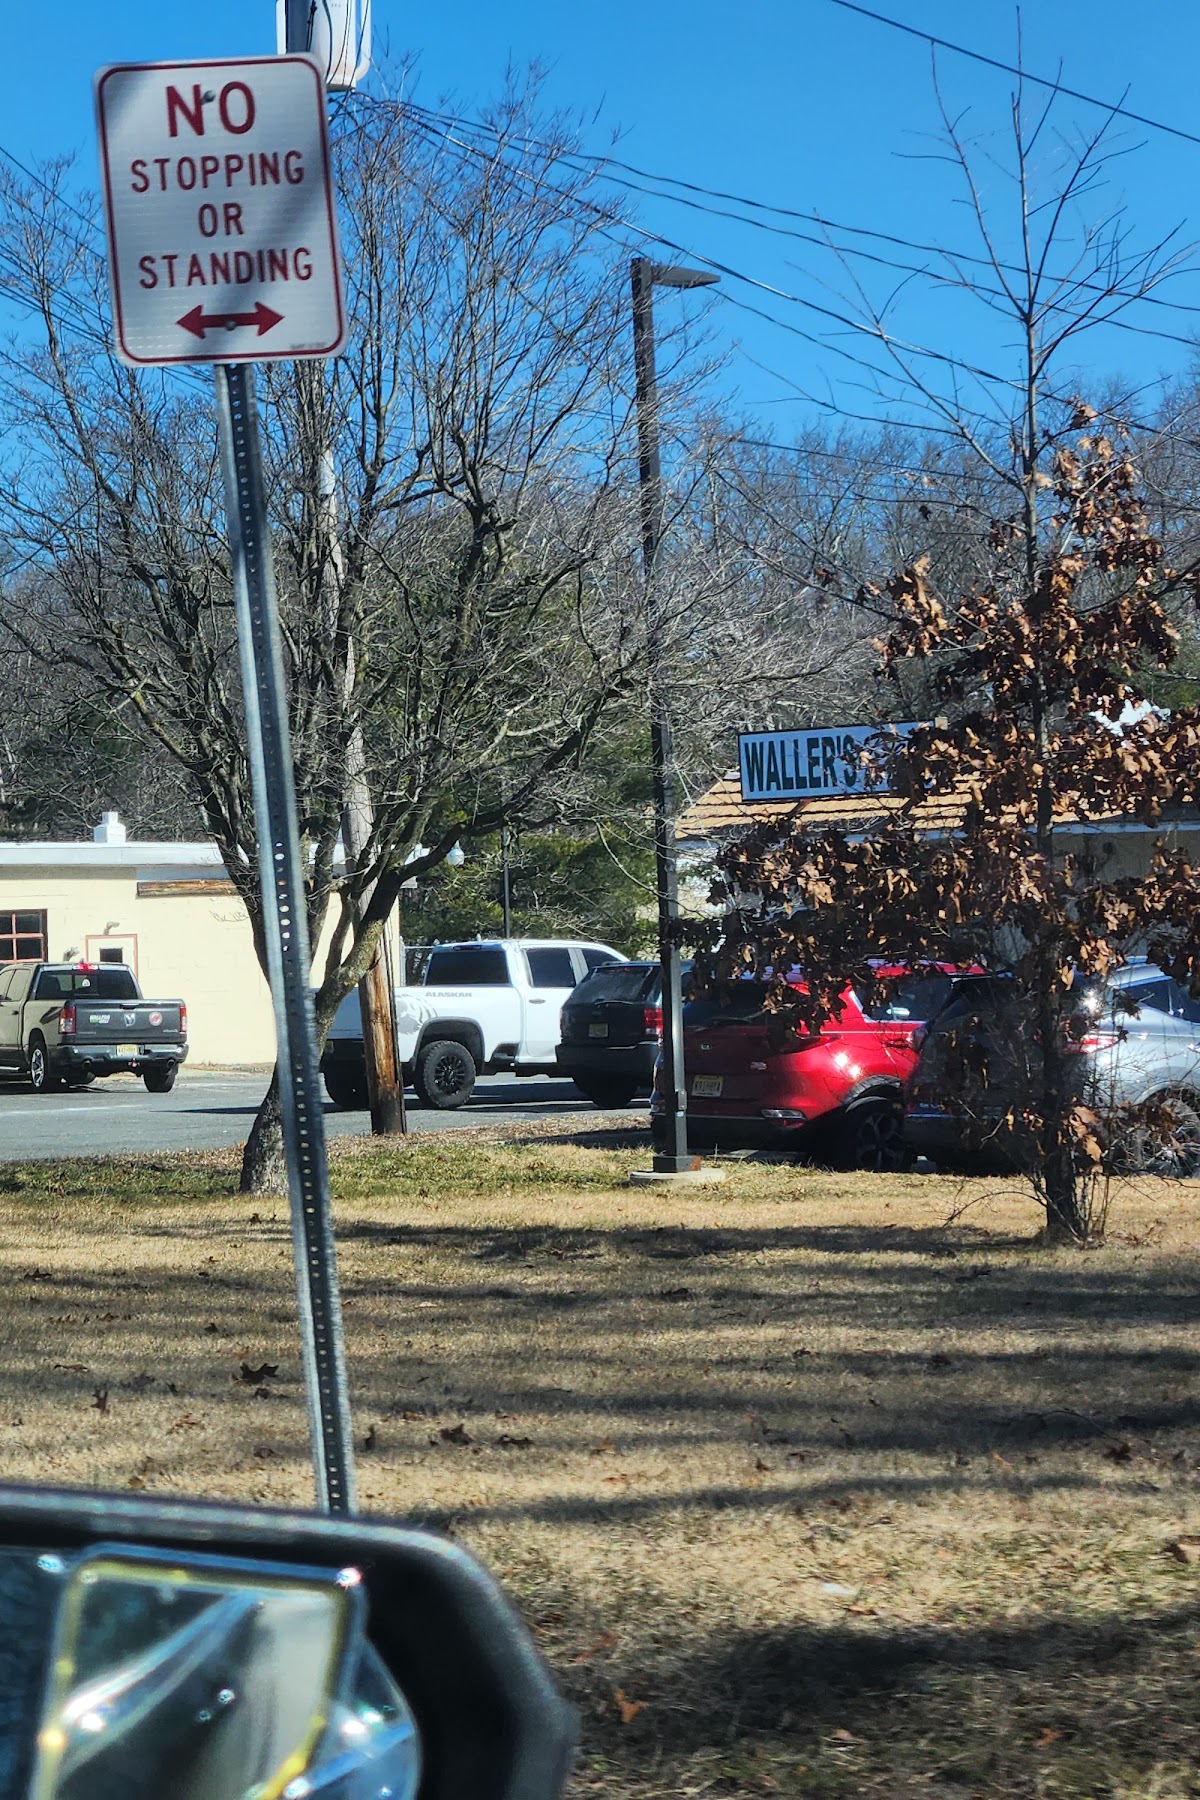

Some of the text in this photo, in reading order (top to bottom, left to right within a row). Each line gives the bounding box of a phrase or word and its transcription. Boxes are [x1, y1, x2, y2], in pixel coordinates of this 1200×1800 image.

[166, 81, 256, 137] NO
[131, 150, 305, 193] STOPPING
[198, 202, 245, 238] OR
[138, 248, 314, 289] STANDING
